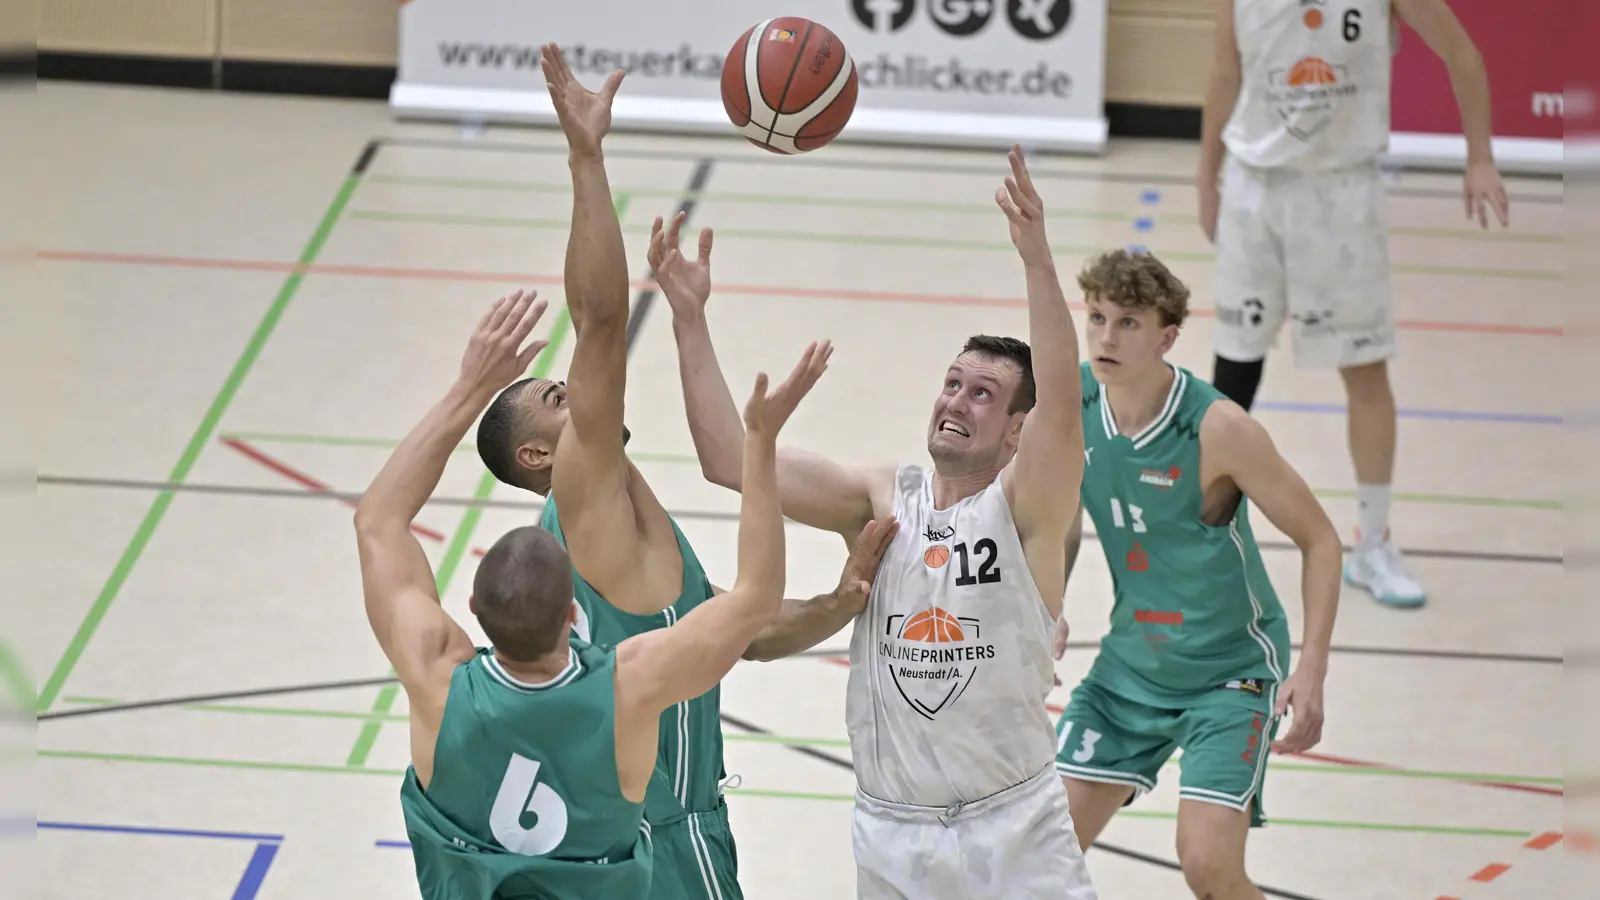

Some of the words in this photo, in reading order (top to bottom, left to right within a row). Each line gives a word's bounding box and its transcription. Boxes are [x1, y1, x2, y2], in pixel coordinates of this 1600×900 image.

[1342, 8, 1361, 42] 6
[1110, 497, 1148, 533] 13
[953, 537, 1001, 587] 12
[879, 644, 995, 664] ONLINEPRINTERS
[899, 666, 963, 680] Neustadt/A.
[1057, 720, 1102, 763] 13
[489, 752, 568, 856] 6
